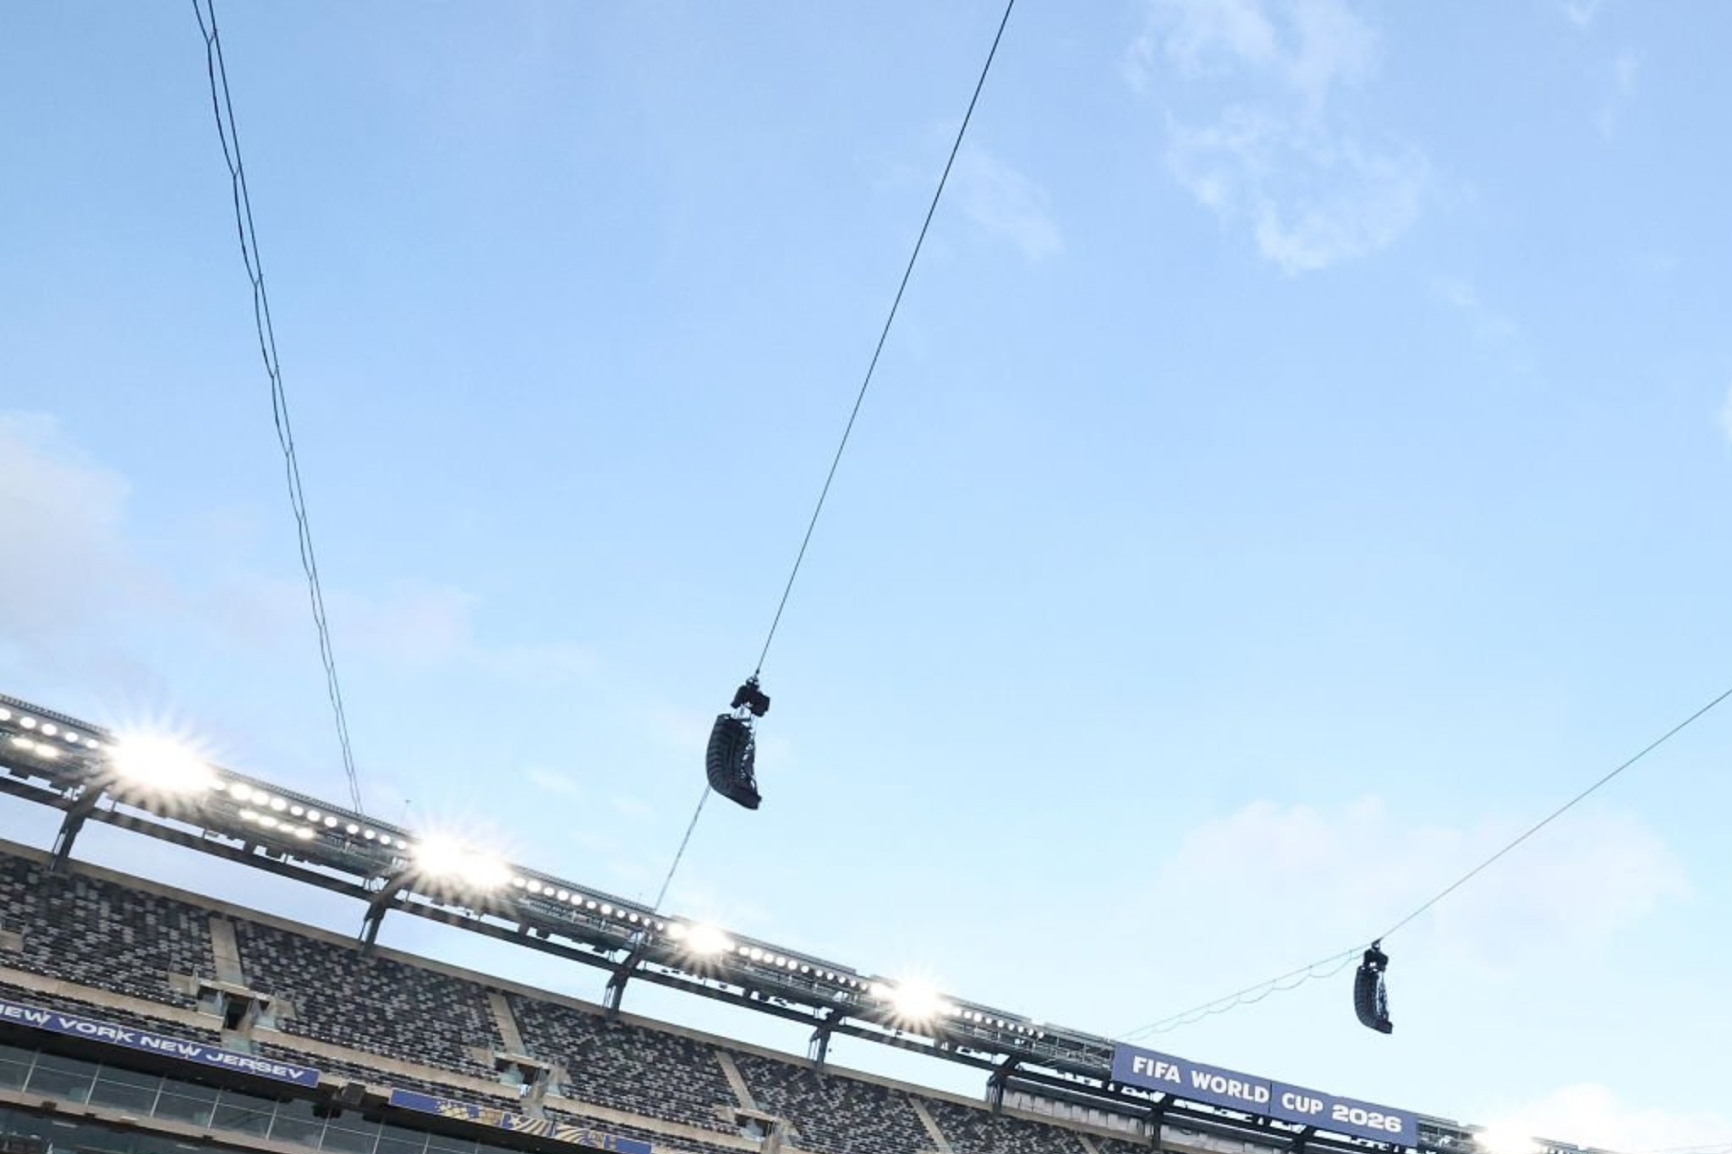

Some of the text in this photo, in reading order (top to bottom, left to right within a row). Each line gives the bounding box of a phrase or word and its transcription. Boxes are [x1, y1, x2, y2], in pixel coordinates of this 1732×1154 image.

[57, 1017, 134, 1043] YORK
[140, 1035, 201, 1056] NEW
[206, 1052, 304, 1079] JERSEY
[1132, 1055, 1403, 1133] FIFA WORLD CUP 2026
